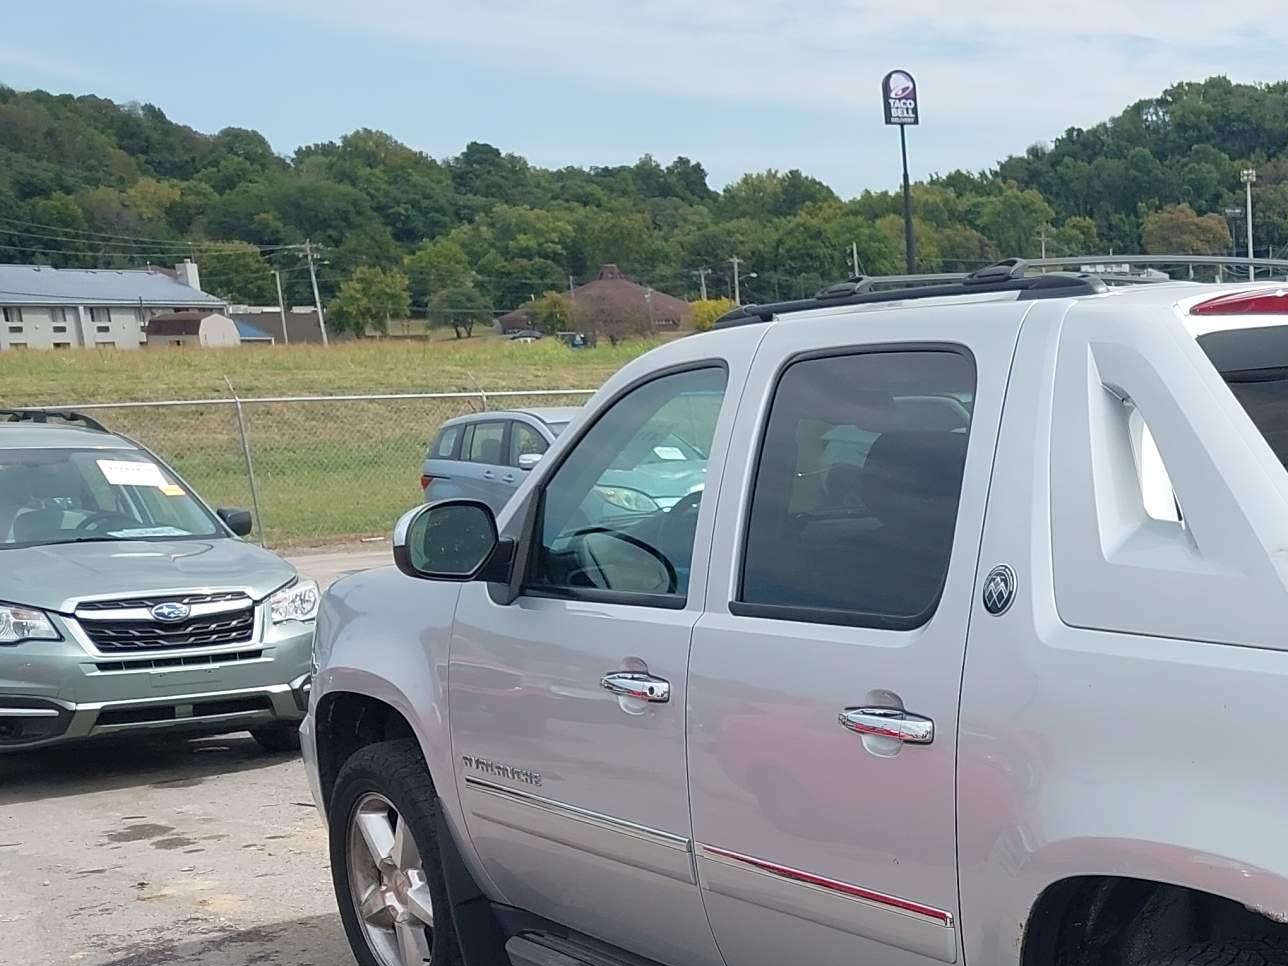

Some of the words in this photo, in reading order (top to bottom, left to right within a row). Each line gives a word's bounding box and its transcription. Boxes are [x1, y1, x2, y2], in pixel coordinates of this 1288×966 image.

[888, 98, 914, 108] TACO
[891, 108, 915, 117] BELL
[462, 754, 542, 787] AVALANCHE
